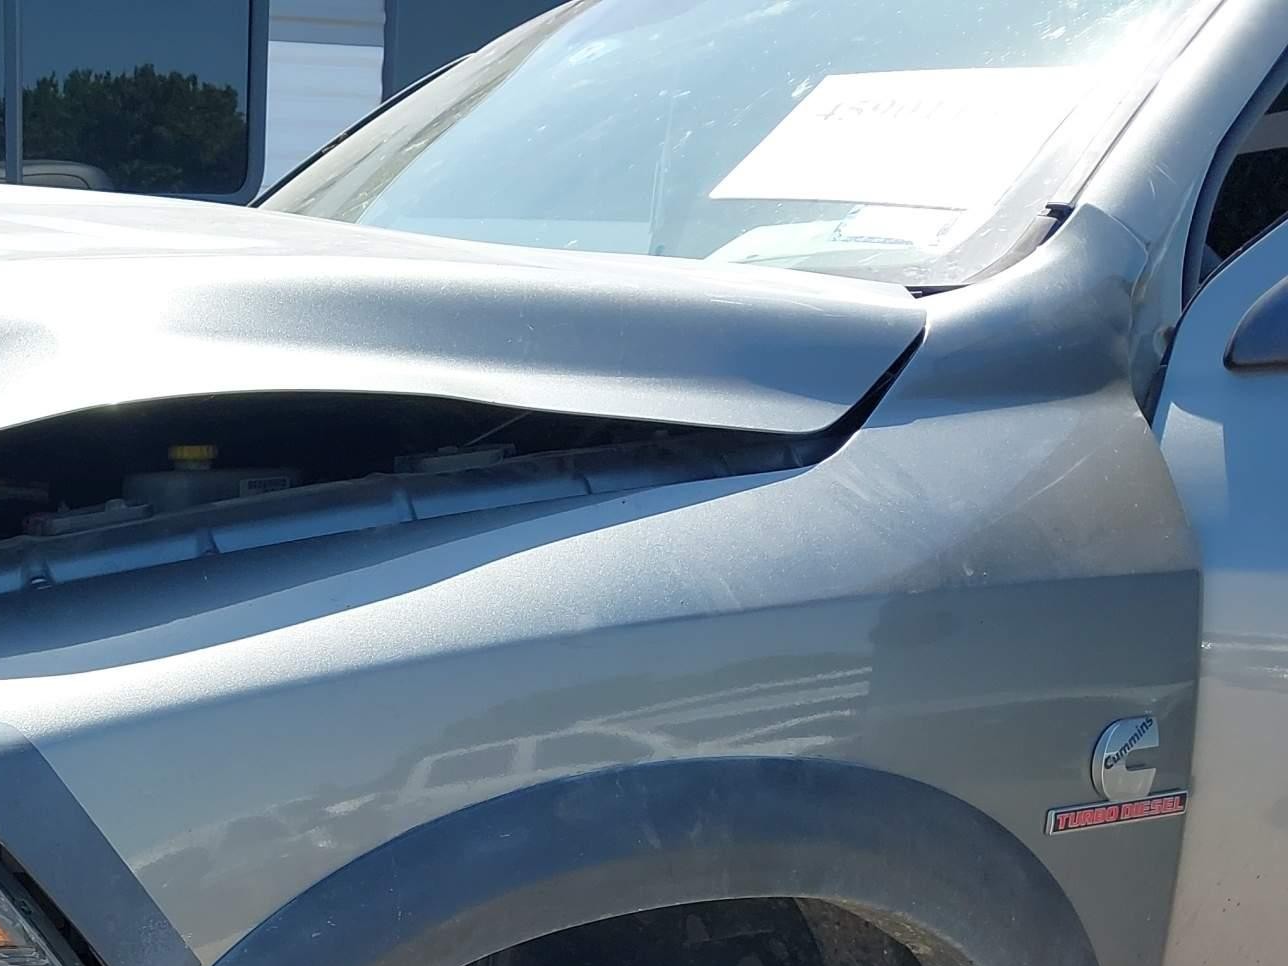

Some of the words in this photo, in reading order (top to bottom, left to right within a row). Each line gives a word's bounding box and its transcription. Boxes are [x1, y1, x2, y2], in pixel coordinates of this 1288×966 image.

[1104, 716, 1154, 769] Cummins
[1057, 806, 1119, 830] TURBO
[1120, 796, 1184, 819] DIESEL
